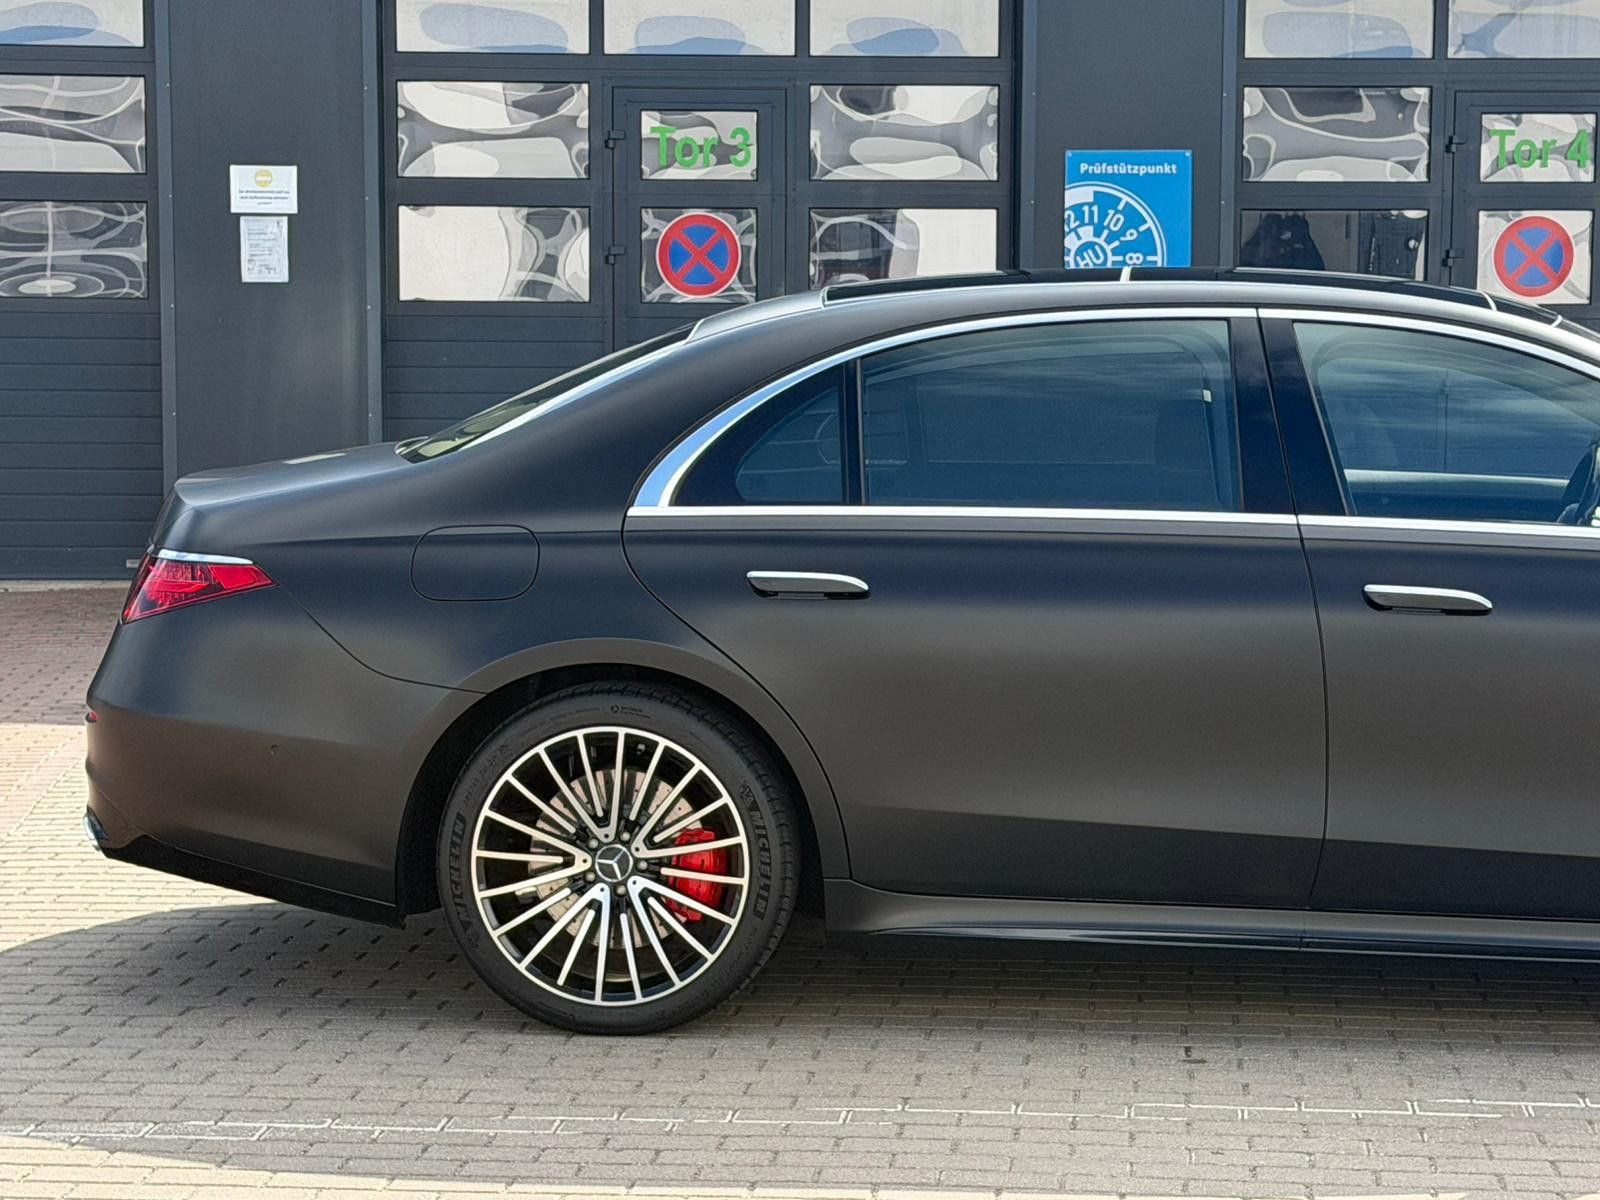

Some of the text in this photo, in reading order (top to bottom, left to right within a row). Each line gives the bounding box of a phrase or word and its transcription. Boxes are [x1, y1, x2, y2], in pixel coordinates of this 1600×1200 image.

[650, 126, 752, 169] Tor 3
[1488, 129, 1589, 169] Tor 4
[1080, 162, 1178, 176] Prüfstützpunkt
[1082, 205, 1099, 224] 11
[1104, 209, 1125, 232] 10
[1120, 229, 1138, 241] 9
[1125, 252, 1144, 265] 8
[449, 816, 471, 921] MICHELIN
[749, 810, 771, 915] MICHELIN
